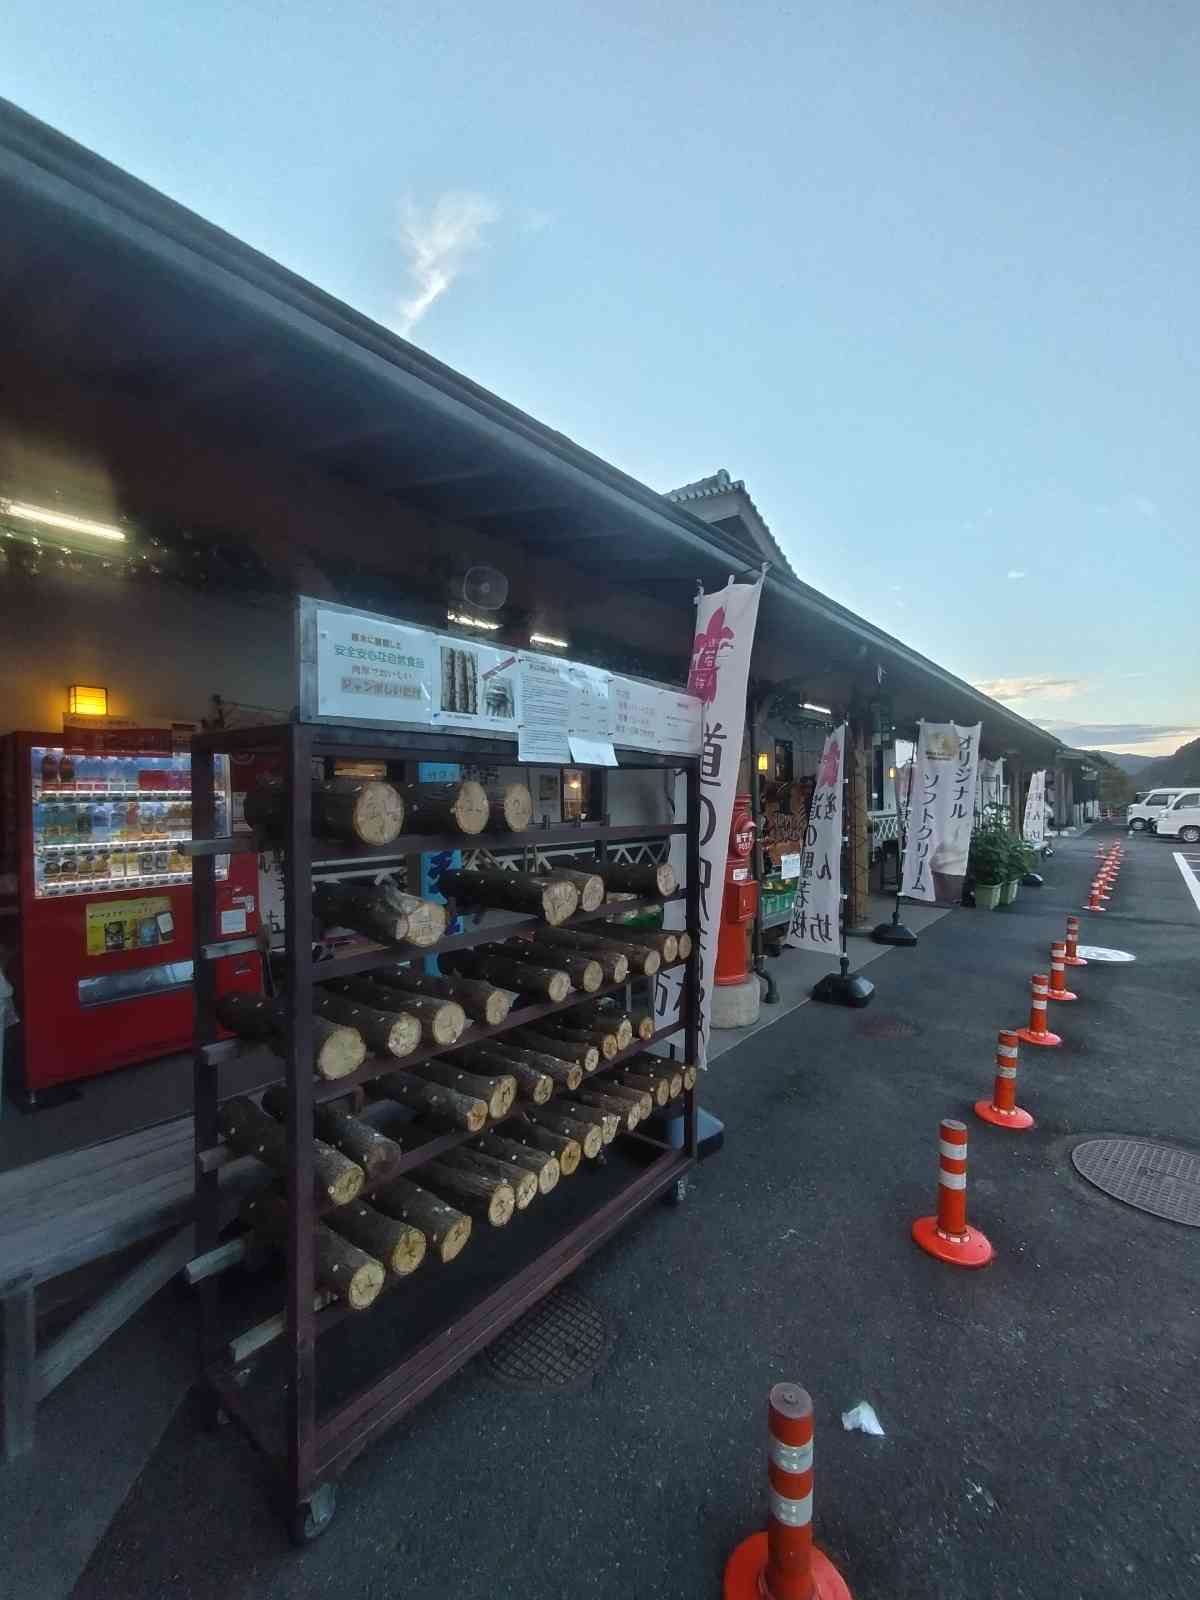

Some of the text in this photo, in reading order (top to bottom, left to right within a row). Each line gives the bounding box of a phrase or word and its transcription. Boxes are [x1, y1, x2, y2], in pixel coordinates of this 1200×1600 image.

[949, 735, 974, 819] オリジナル
[909, 773, 940, 893] ソフトクリーム
